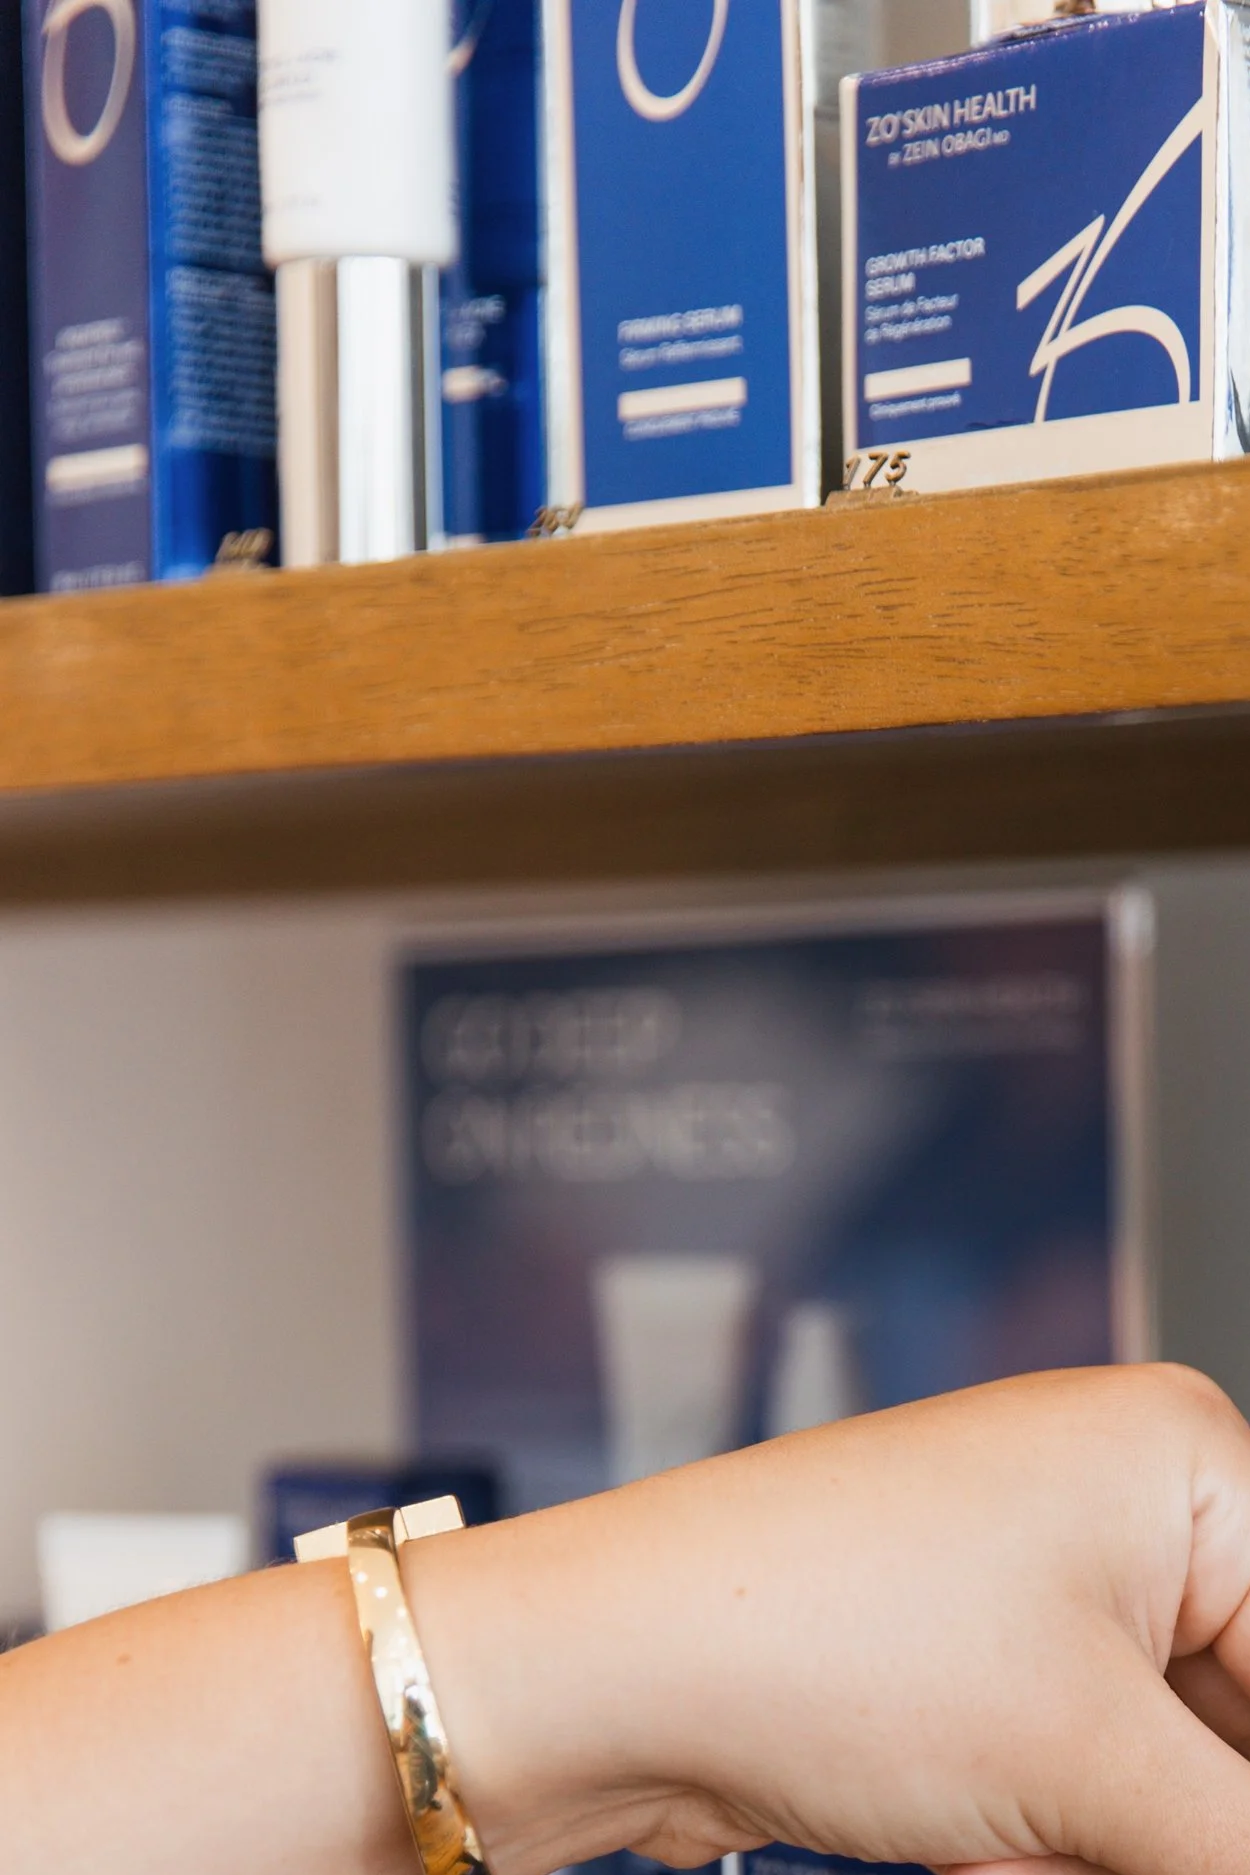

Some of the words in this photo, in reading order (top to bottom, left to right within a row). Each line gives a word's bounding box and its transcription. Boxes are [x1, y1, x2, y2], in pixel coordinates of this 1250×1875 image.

[902, 102, 951, 139] SKIN
[953, 84, 1037, 127] HEALTH
[902, 138, 940, 166] ZEIN
[941, 127, 992, 157] OBAGI
[929, 237, 986, 264] FACTOR
[842, 450, 911, 488] 175
